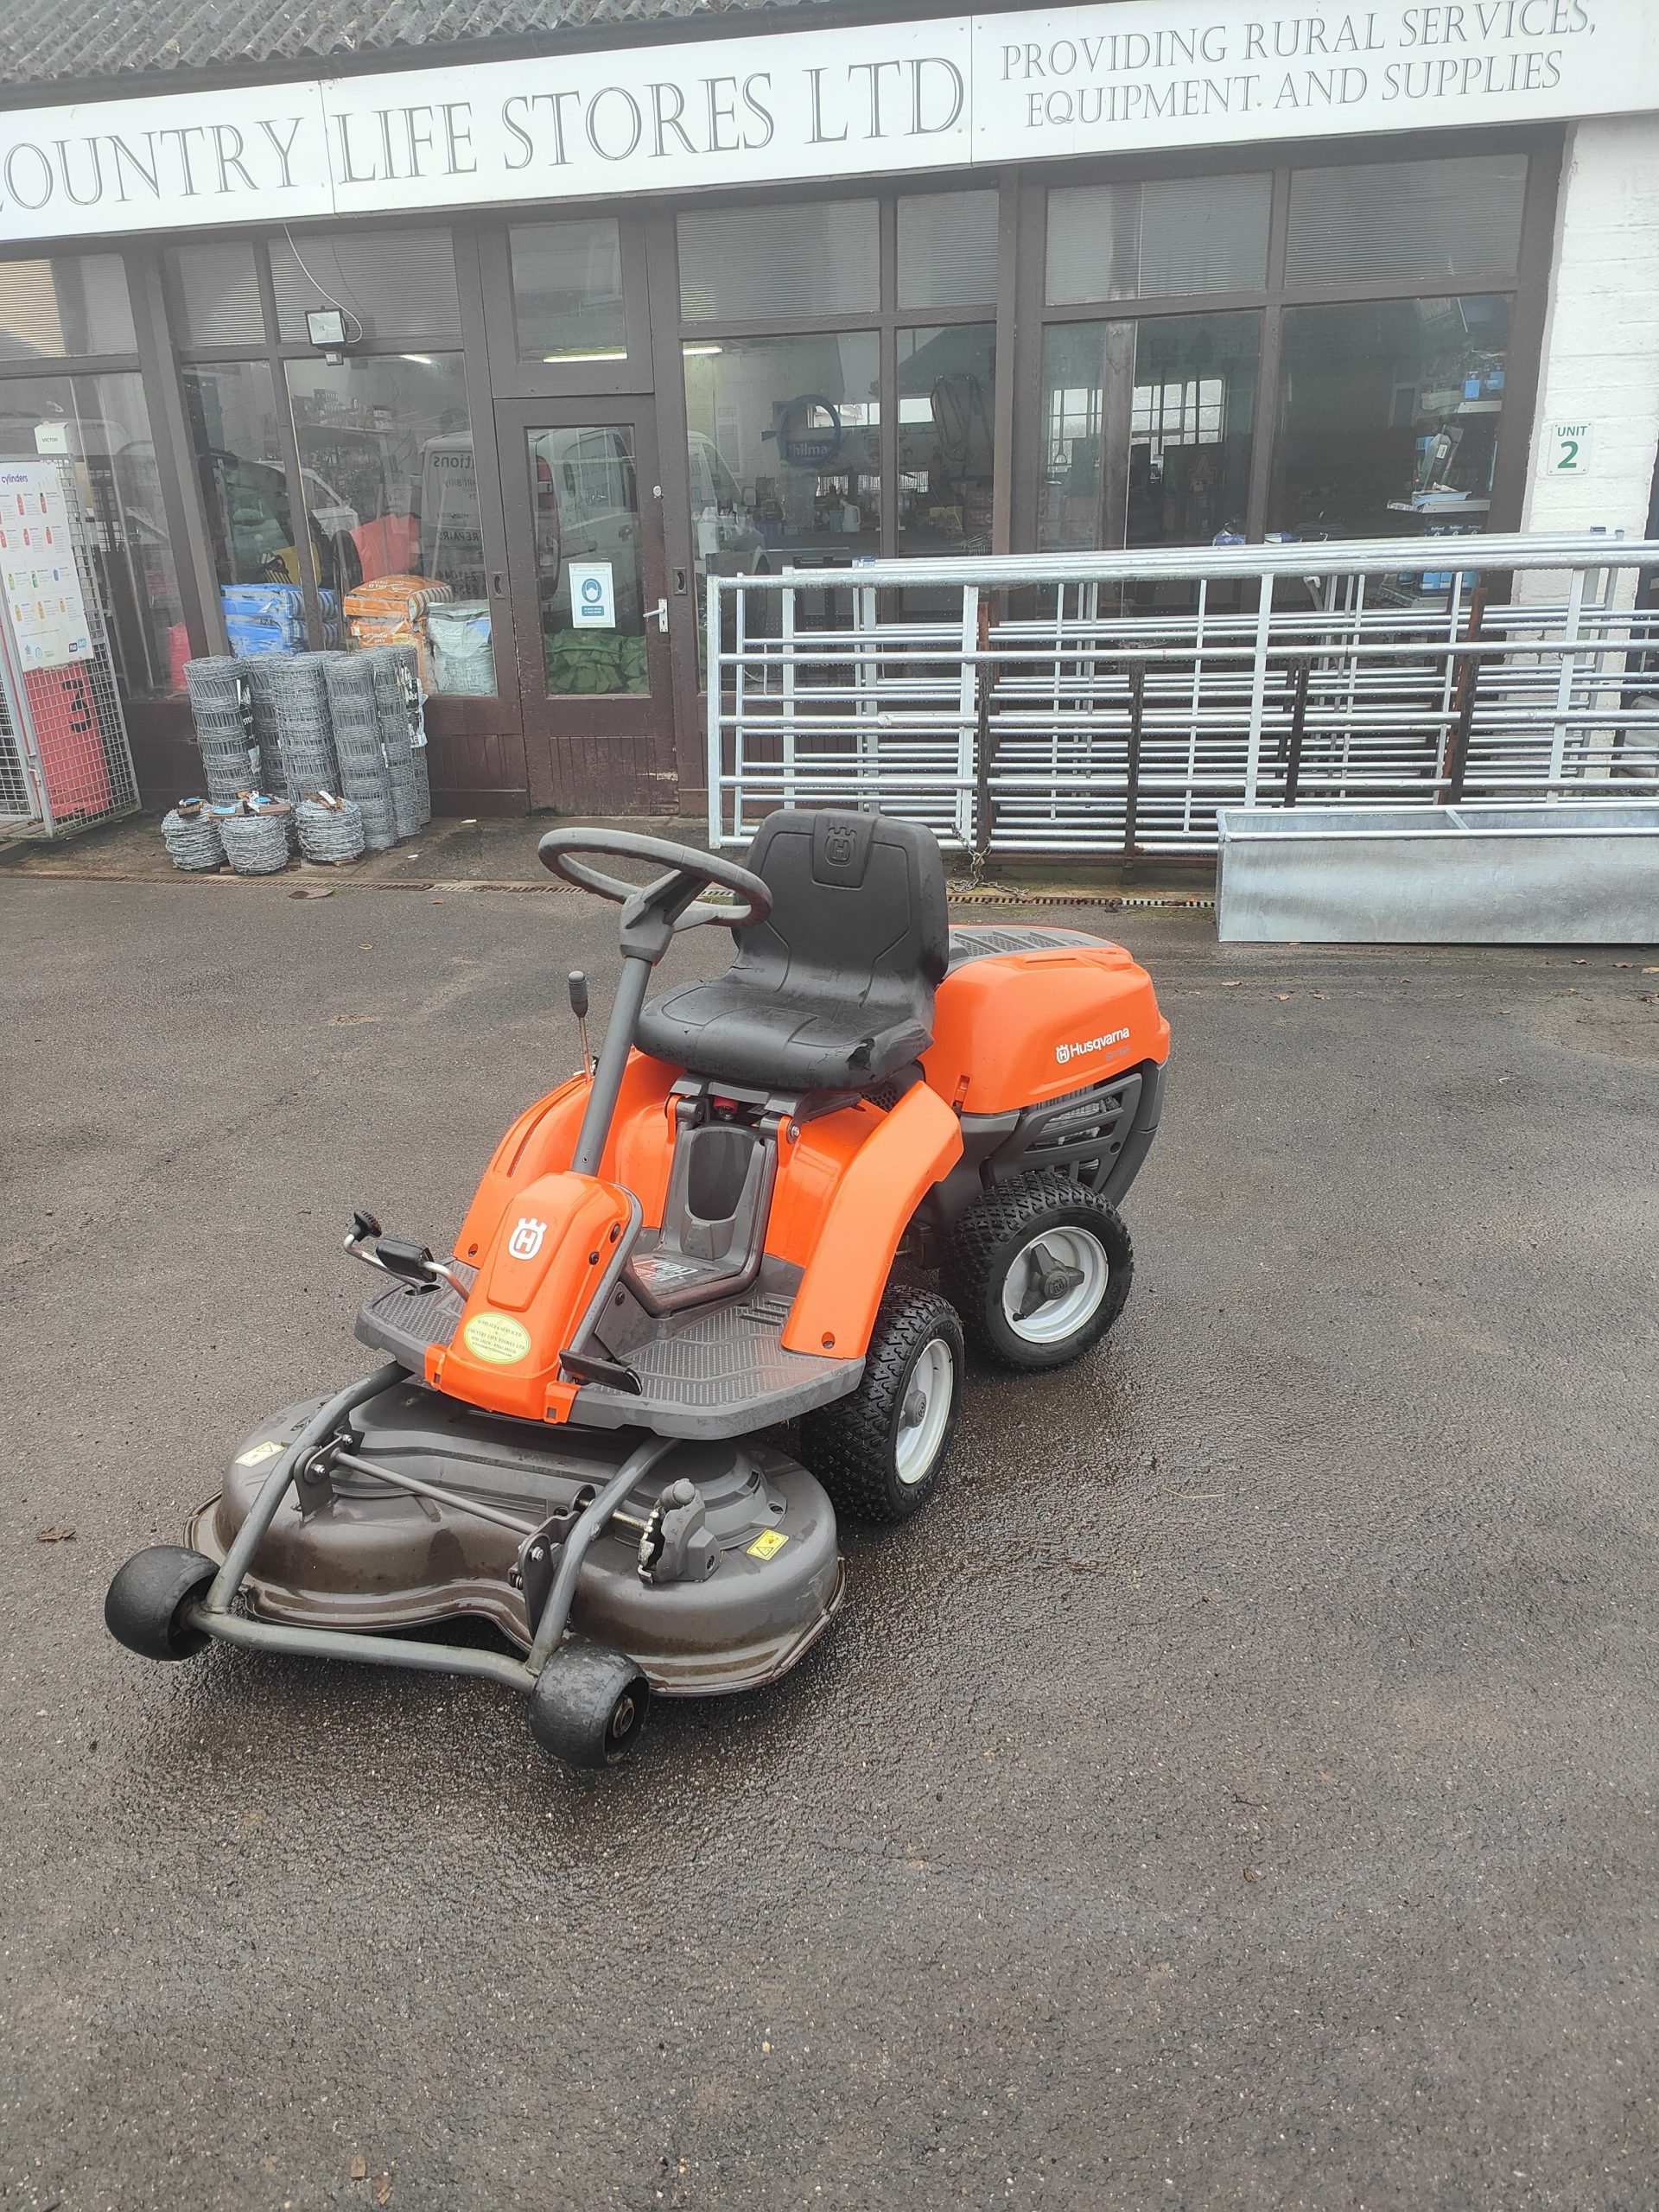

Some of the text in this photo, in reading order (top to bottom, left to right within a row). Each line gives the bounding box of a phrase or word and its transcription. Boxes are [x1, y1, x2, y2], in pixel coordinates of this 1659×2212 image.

[1000, 0, 1596, 80] PROVIDING RURAL SERVICES,
[1274, 66, 1368, 109] AND
[1382, 50, 1563, 101] SUPPLIES
[0, 57, 964, 213] OUNTRY LIFE STORES LTD
[1557, 425, 1588, 437] UNIT
[1557, 441, 1579, 469] 2
[2, 474, 29, 485] cylinders
[62, 680, 92, 734] 3
[1070, 1027, 1130, 1058] Husqvarna
